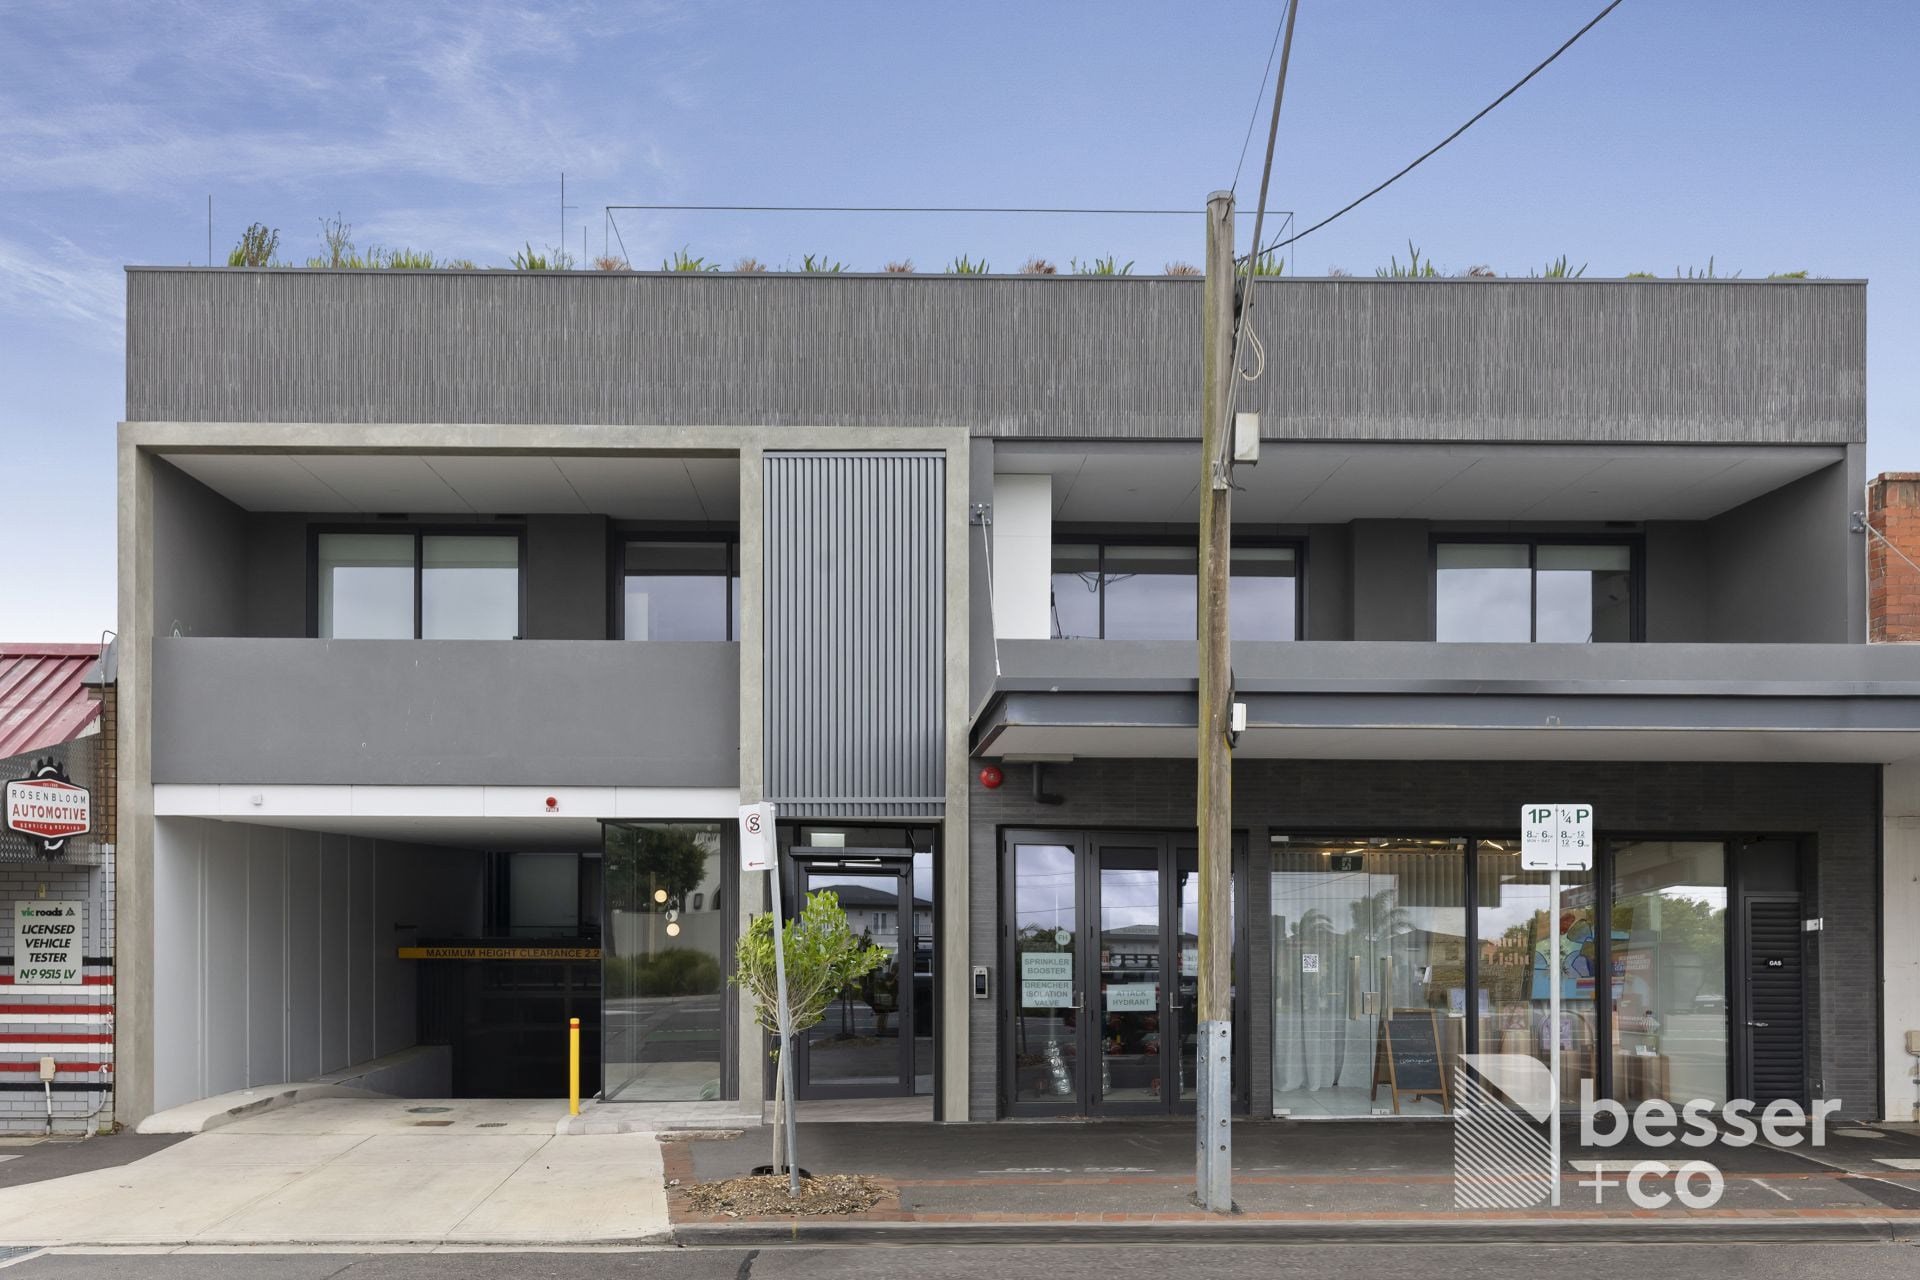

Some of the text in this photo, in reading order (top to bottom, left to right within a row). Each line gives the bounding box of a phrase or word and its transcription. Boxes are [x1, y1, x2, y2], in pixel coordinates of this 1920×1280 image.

[12, 789, 86, 804] ROSENBLOOM
[13, 803, 87, 821] AUTOMOTIVE
[1528, 808, 1552, 824] 1P
[1576, 808, 1590, 824] P
[35, 906, 63, 917] roads
[21, 924, 75, 935] LICENSED
[25, 938, 71, 949] VEHICLE
[29, 952, 67, 963] TESTER
[426, 949, 475, 958] MAXIMUM
[478, 949, 515, 958] HEIGHT
[519, 949, 582, 958] CLEARANCE
[1024, 958, 1070, 966] SPRINKLER
[39, 968, 61, 979] 9515
[63, 968, 76, 979] LV
[1027, 967, 1066, 975] BOOSTER
[1024, 981, 1069, 989] DRENCHER
[1026, 990, 1068, 998] ISOLATION
[1034, 999, 1059, 1007] VALVE
